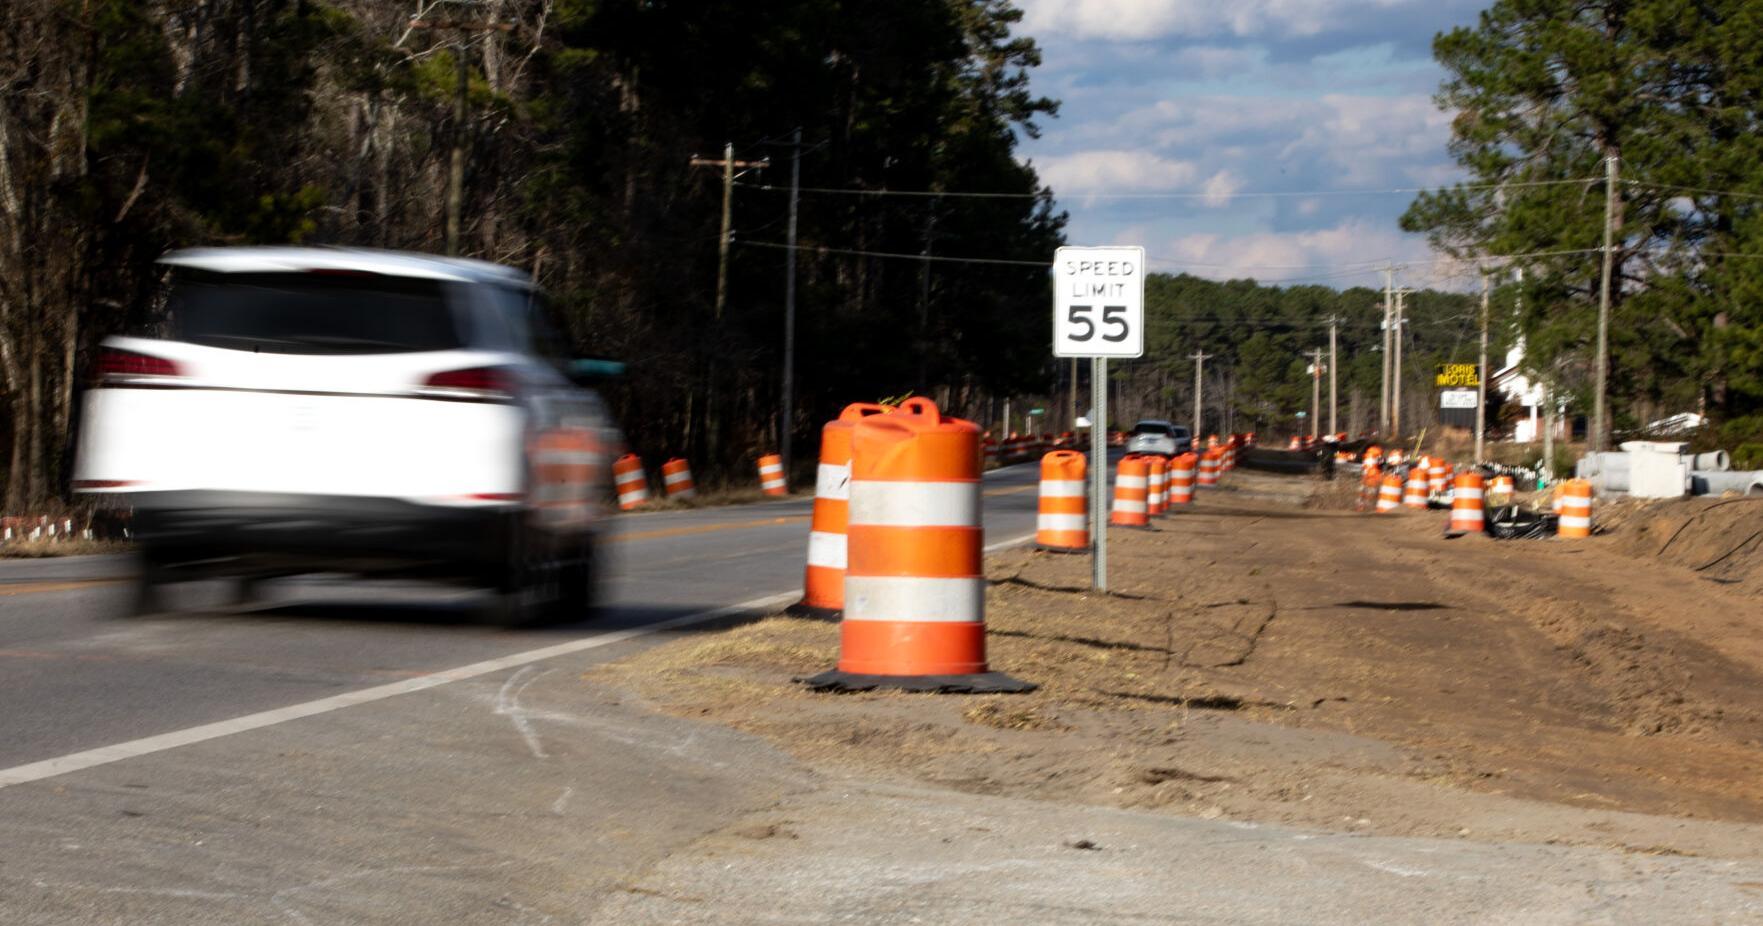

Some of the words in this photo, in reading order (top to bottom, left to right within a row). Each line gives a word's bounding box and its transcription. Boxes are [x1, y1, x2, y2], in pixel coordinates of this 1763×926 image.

[1066, 261, 1134, 276] SPEED
[1072, 283, 1125, 298] LIMIT
[1067, 305, 1130, 343] 55
[1446, 364, 1476, 374] LORIS
[1437, 374, 1481, 386] MOTEL
